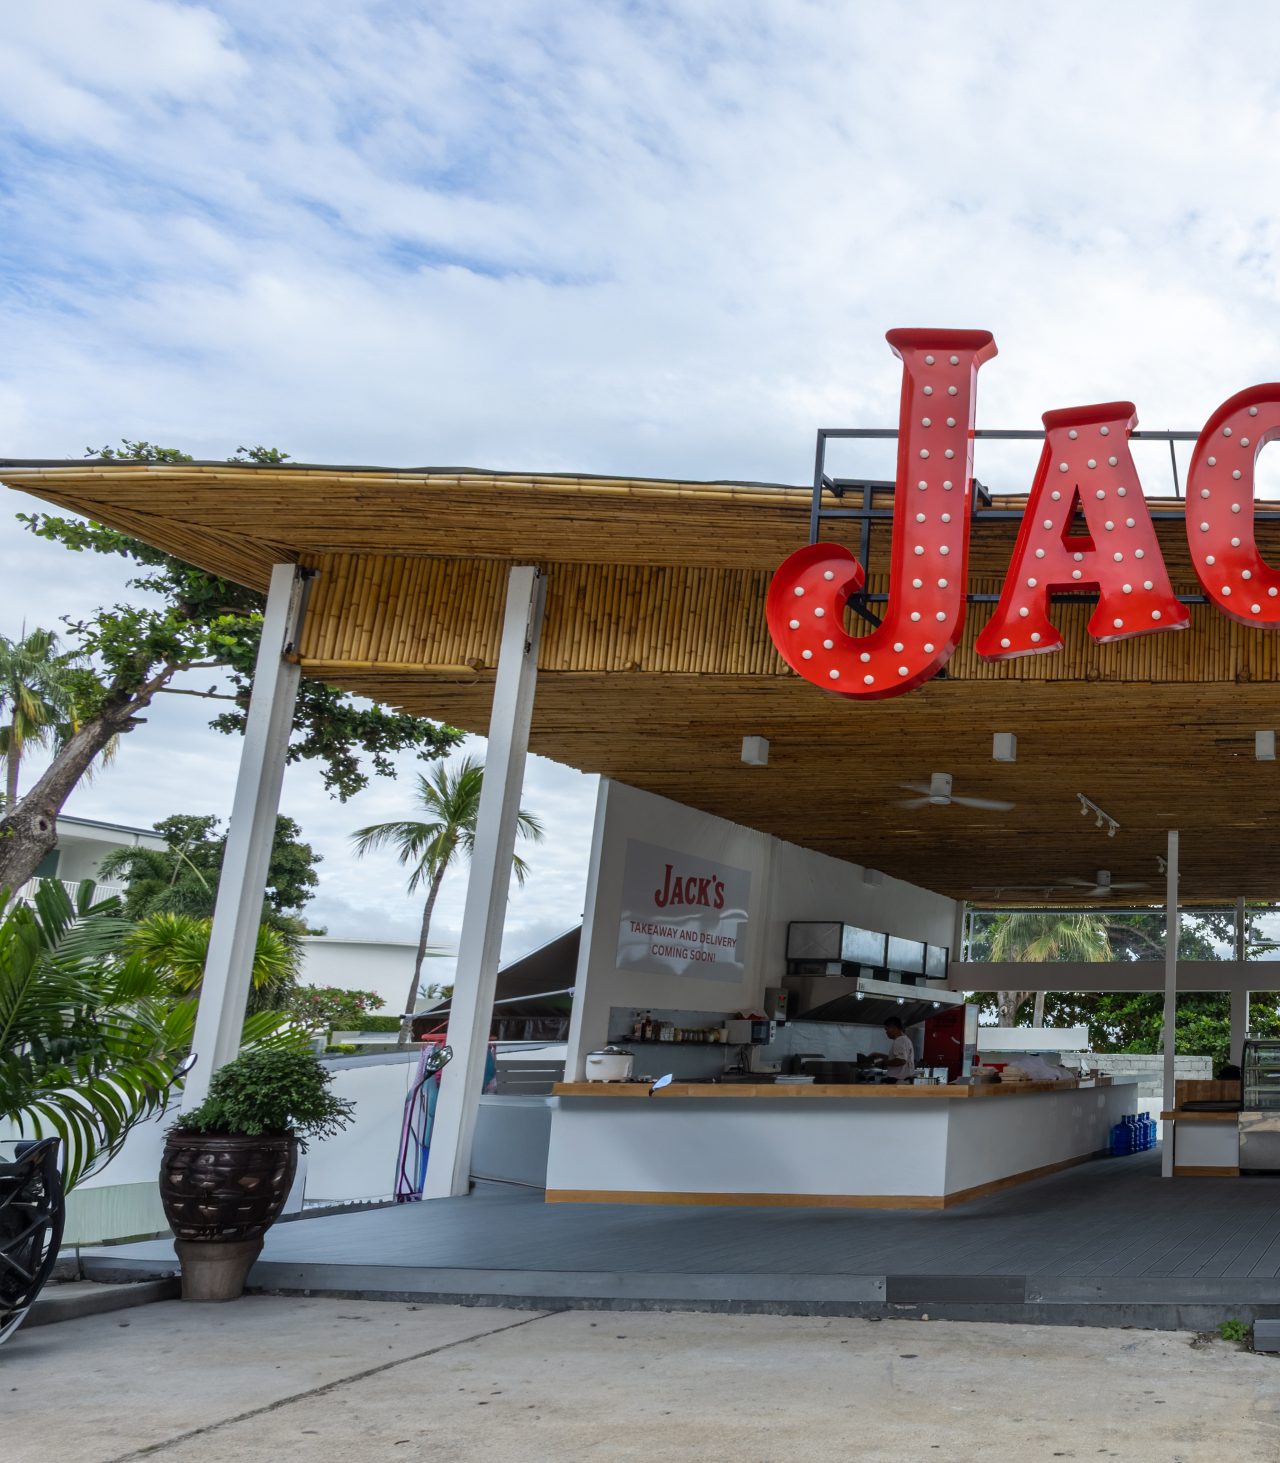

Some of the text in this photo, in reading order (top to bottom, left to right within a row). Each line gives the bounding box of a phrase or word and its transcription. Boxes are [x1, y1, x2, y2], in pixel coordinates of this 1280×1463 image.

[654, 864, 725, 910] JACK'S
[630, 921, 737, 948] TAKEAWAY AND DELIVERY
[651, 944, 716, 963] COMING SOON!
